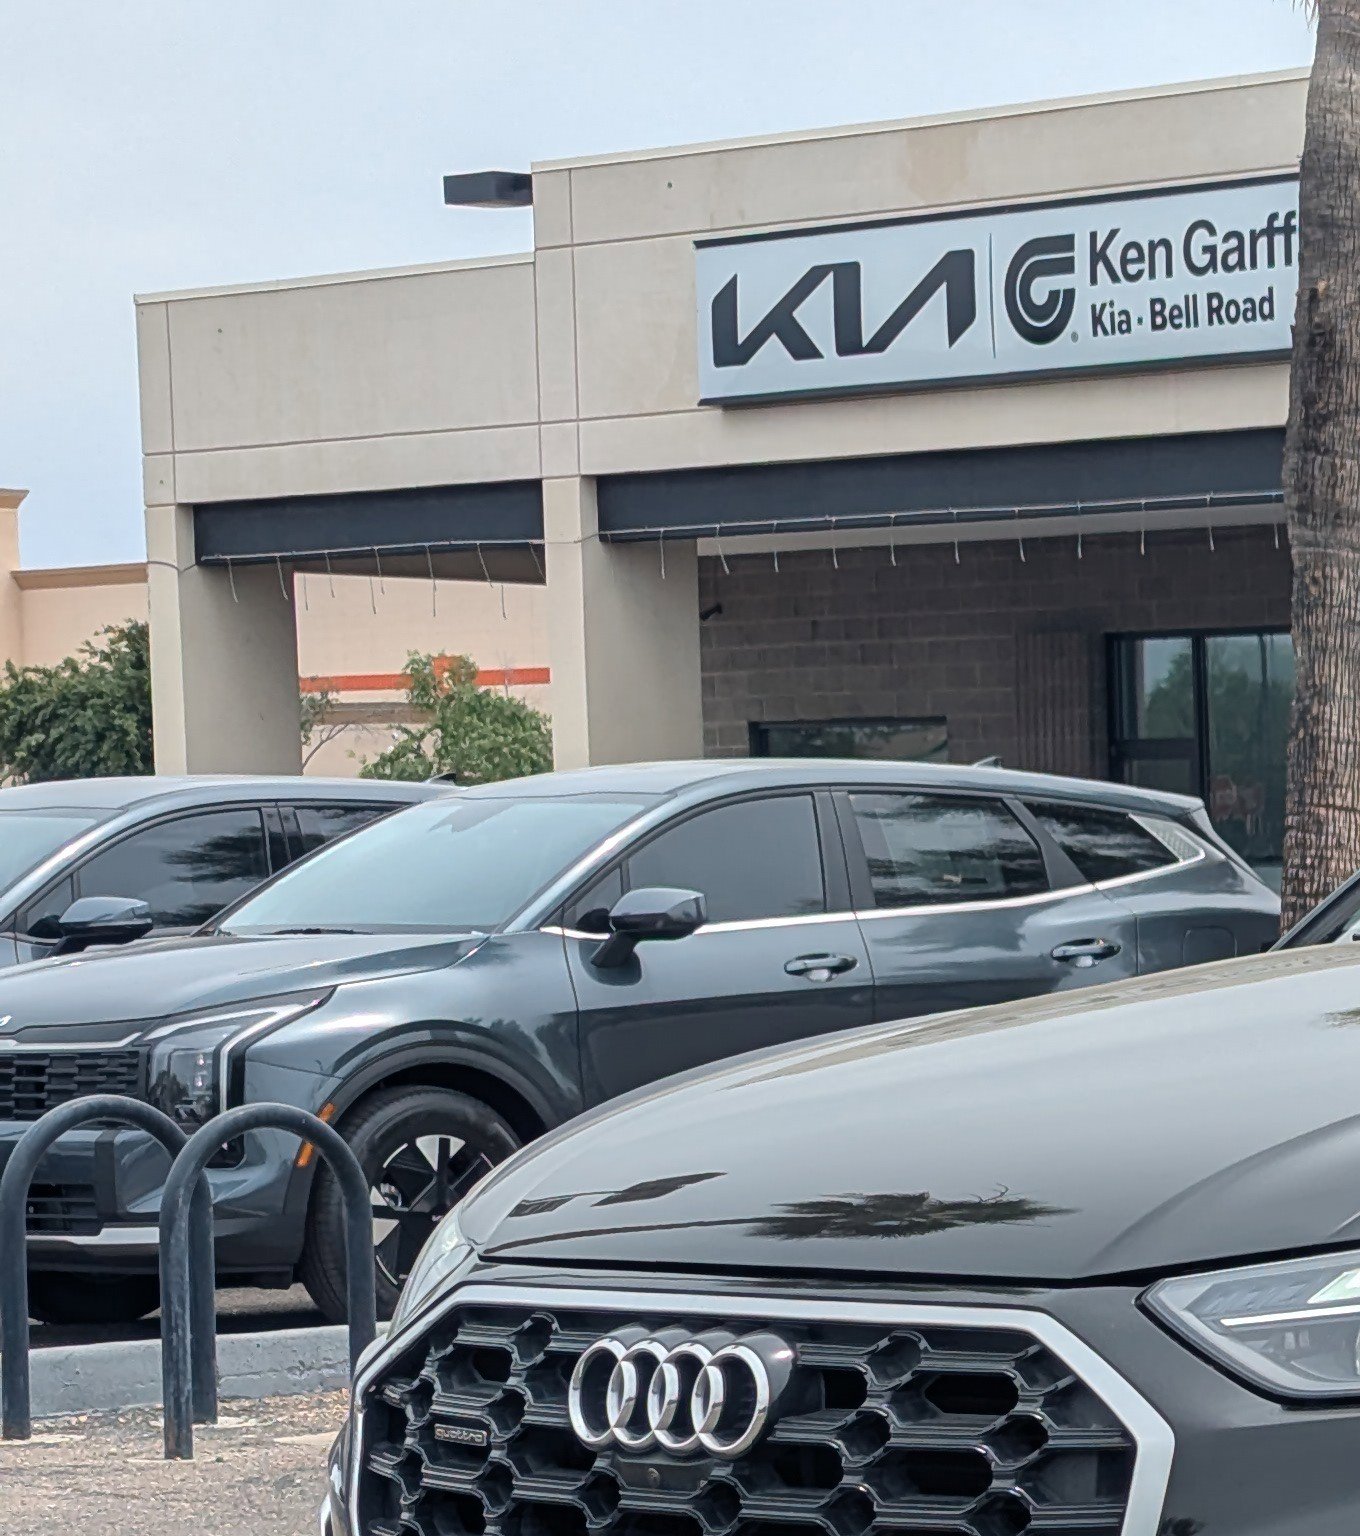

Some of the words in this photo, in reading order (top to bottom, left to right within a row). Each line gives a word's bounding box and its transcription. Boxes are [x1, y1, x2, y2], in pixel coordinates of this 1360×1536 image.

[1089, 227, 1174, 286] Ken
[1182, 210, 1297, 276] Garff
[711, 248, 977, 368] KIA
[1090, 300, 1132, 337] Kia
[1149, 293, 1200, 332] Bell
[1206, 286, 1275, 325] Road
